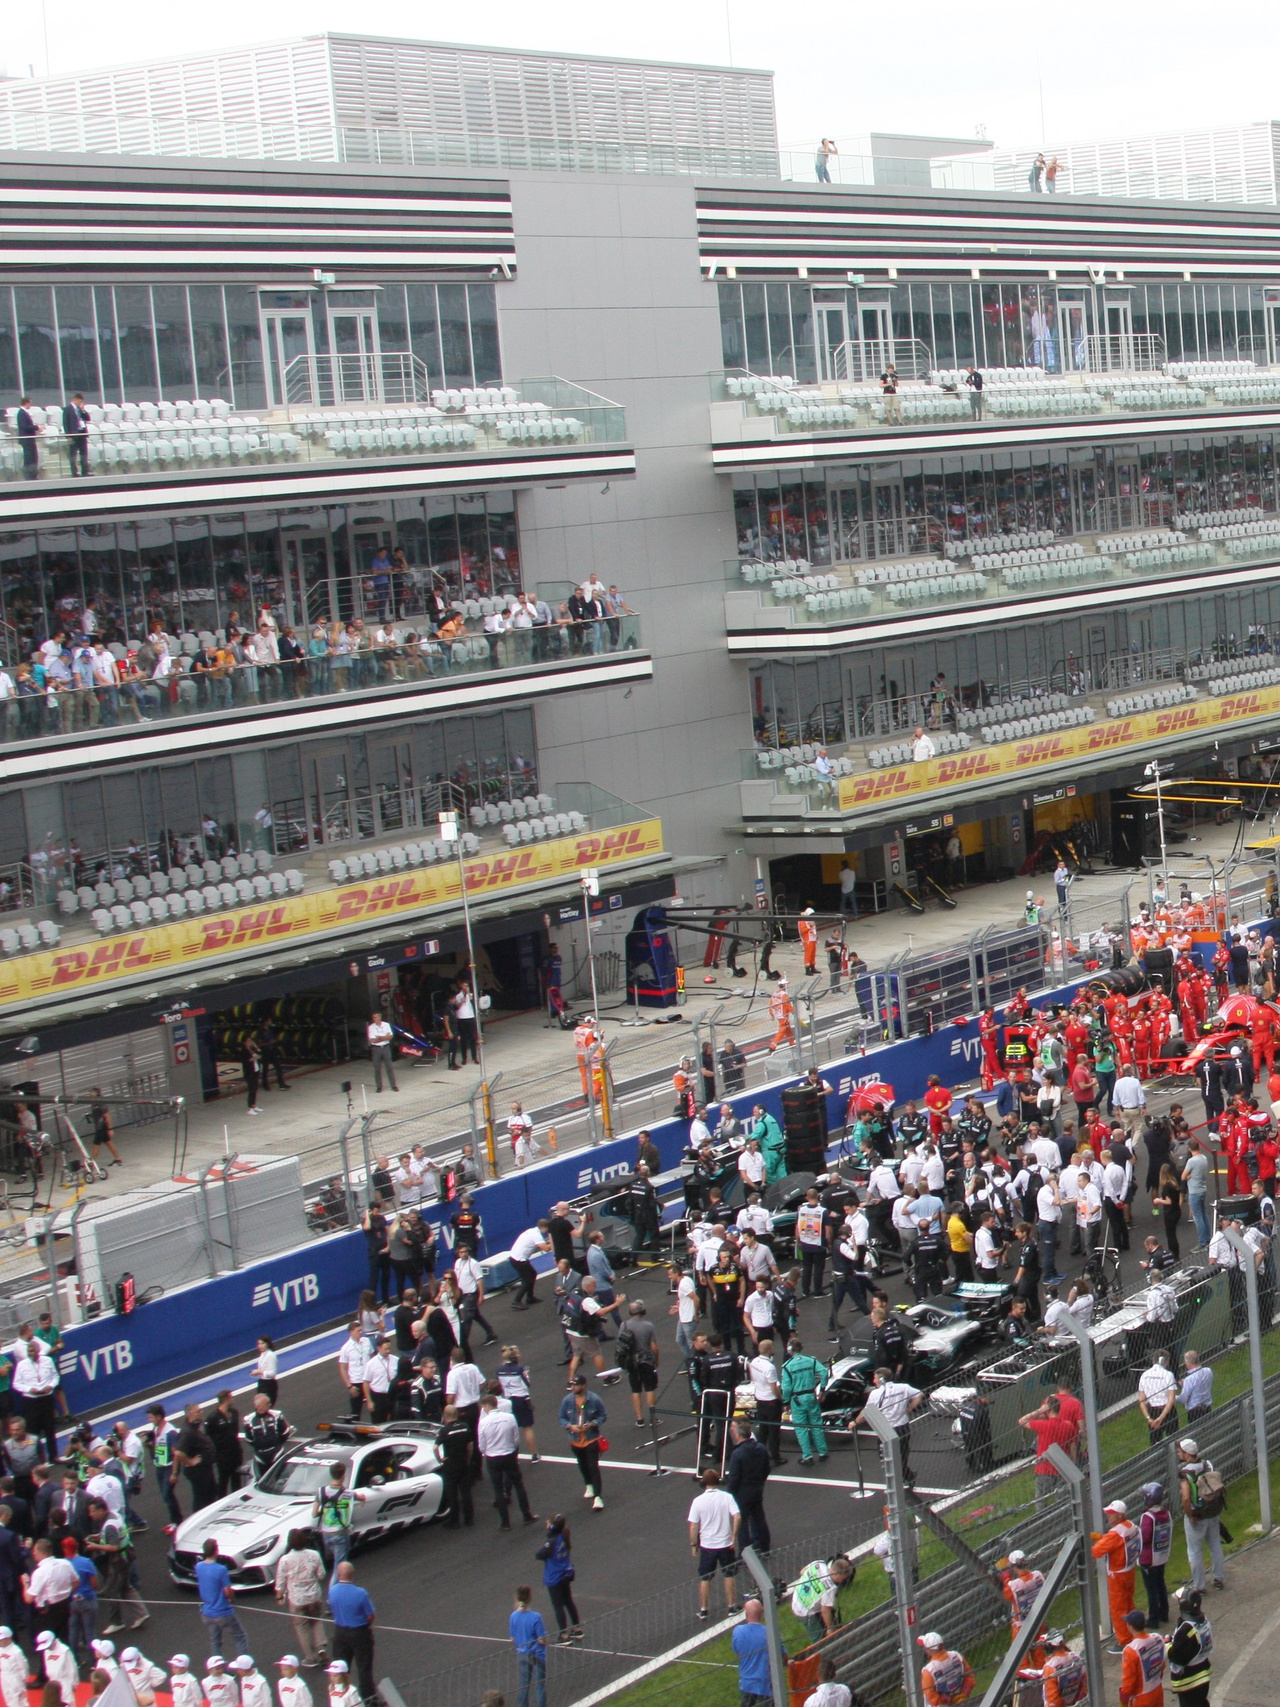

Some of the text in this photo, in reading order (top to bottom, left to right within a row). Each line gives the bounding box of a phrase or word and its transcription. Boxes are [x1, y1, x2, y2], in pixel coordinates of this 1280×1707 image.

[1156, 707, 1201, 734] DHL
[1220, 694, 1261, 720] DHL
[1087, 722, 1135, 749] DHL
[1015, 737, 1065, 765] DHL
[938, 753, 990, 783] DHL
[854, 771, 911, 802] DHL
[1055, 789, 1063, 797] 27
[931, 818, 939, 827] 55
[576, 829, 645, 866] DHL
[463, 853, 539, 891] DHL
[337, 878, 422, 920] DHL
[201, 907, 293, 951] DHL
[51, 938, 153, 986] DHL
[163, 1012, 182, 1023] Toro
[272, 1273, 320, 1312] VTB
[961, 1282, 1008, 1291] PETRONAS
[80, 1340, 134, 1382] VTB
[301, 1457, 340, 1466] AMG
[269, 1507, 289, 1516] CAR
